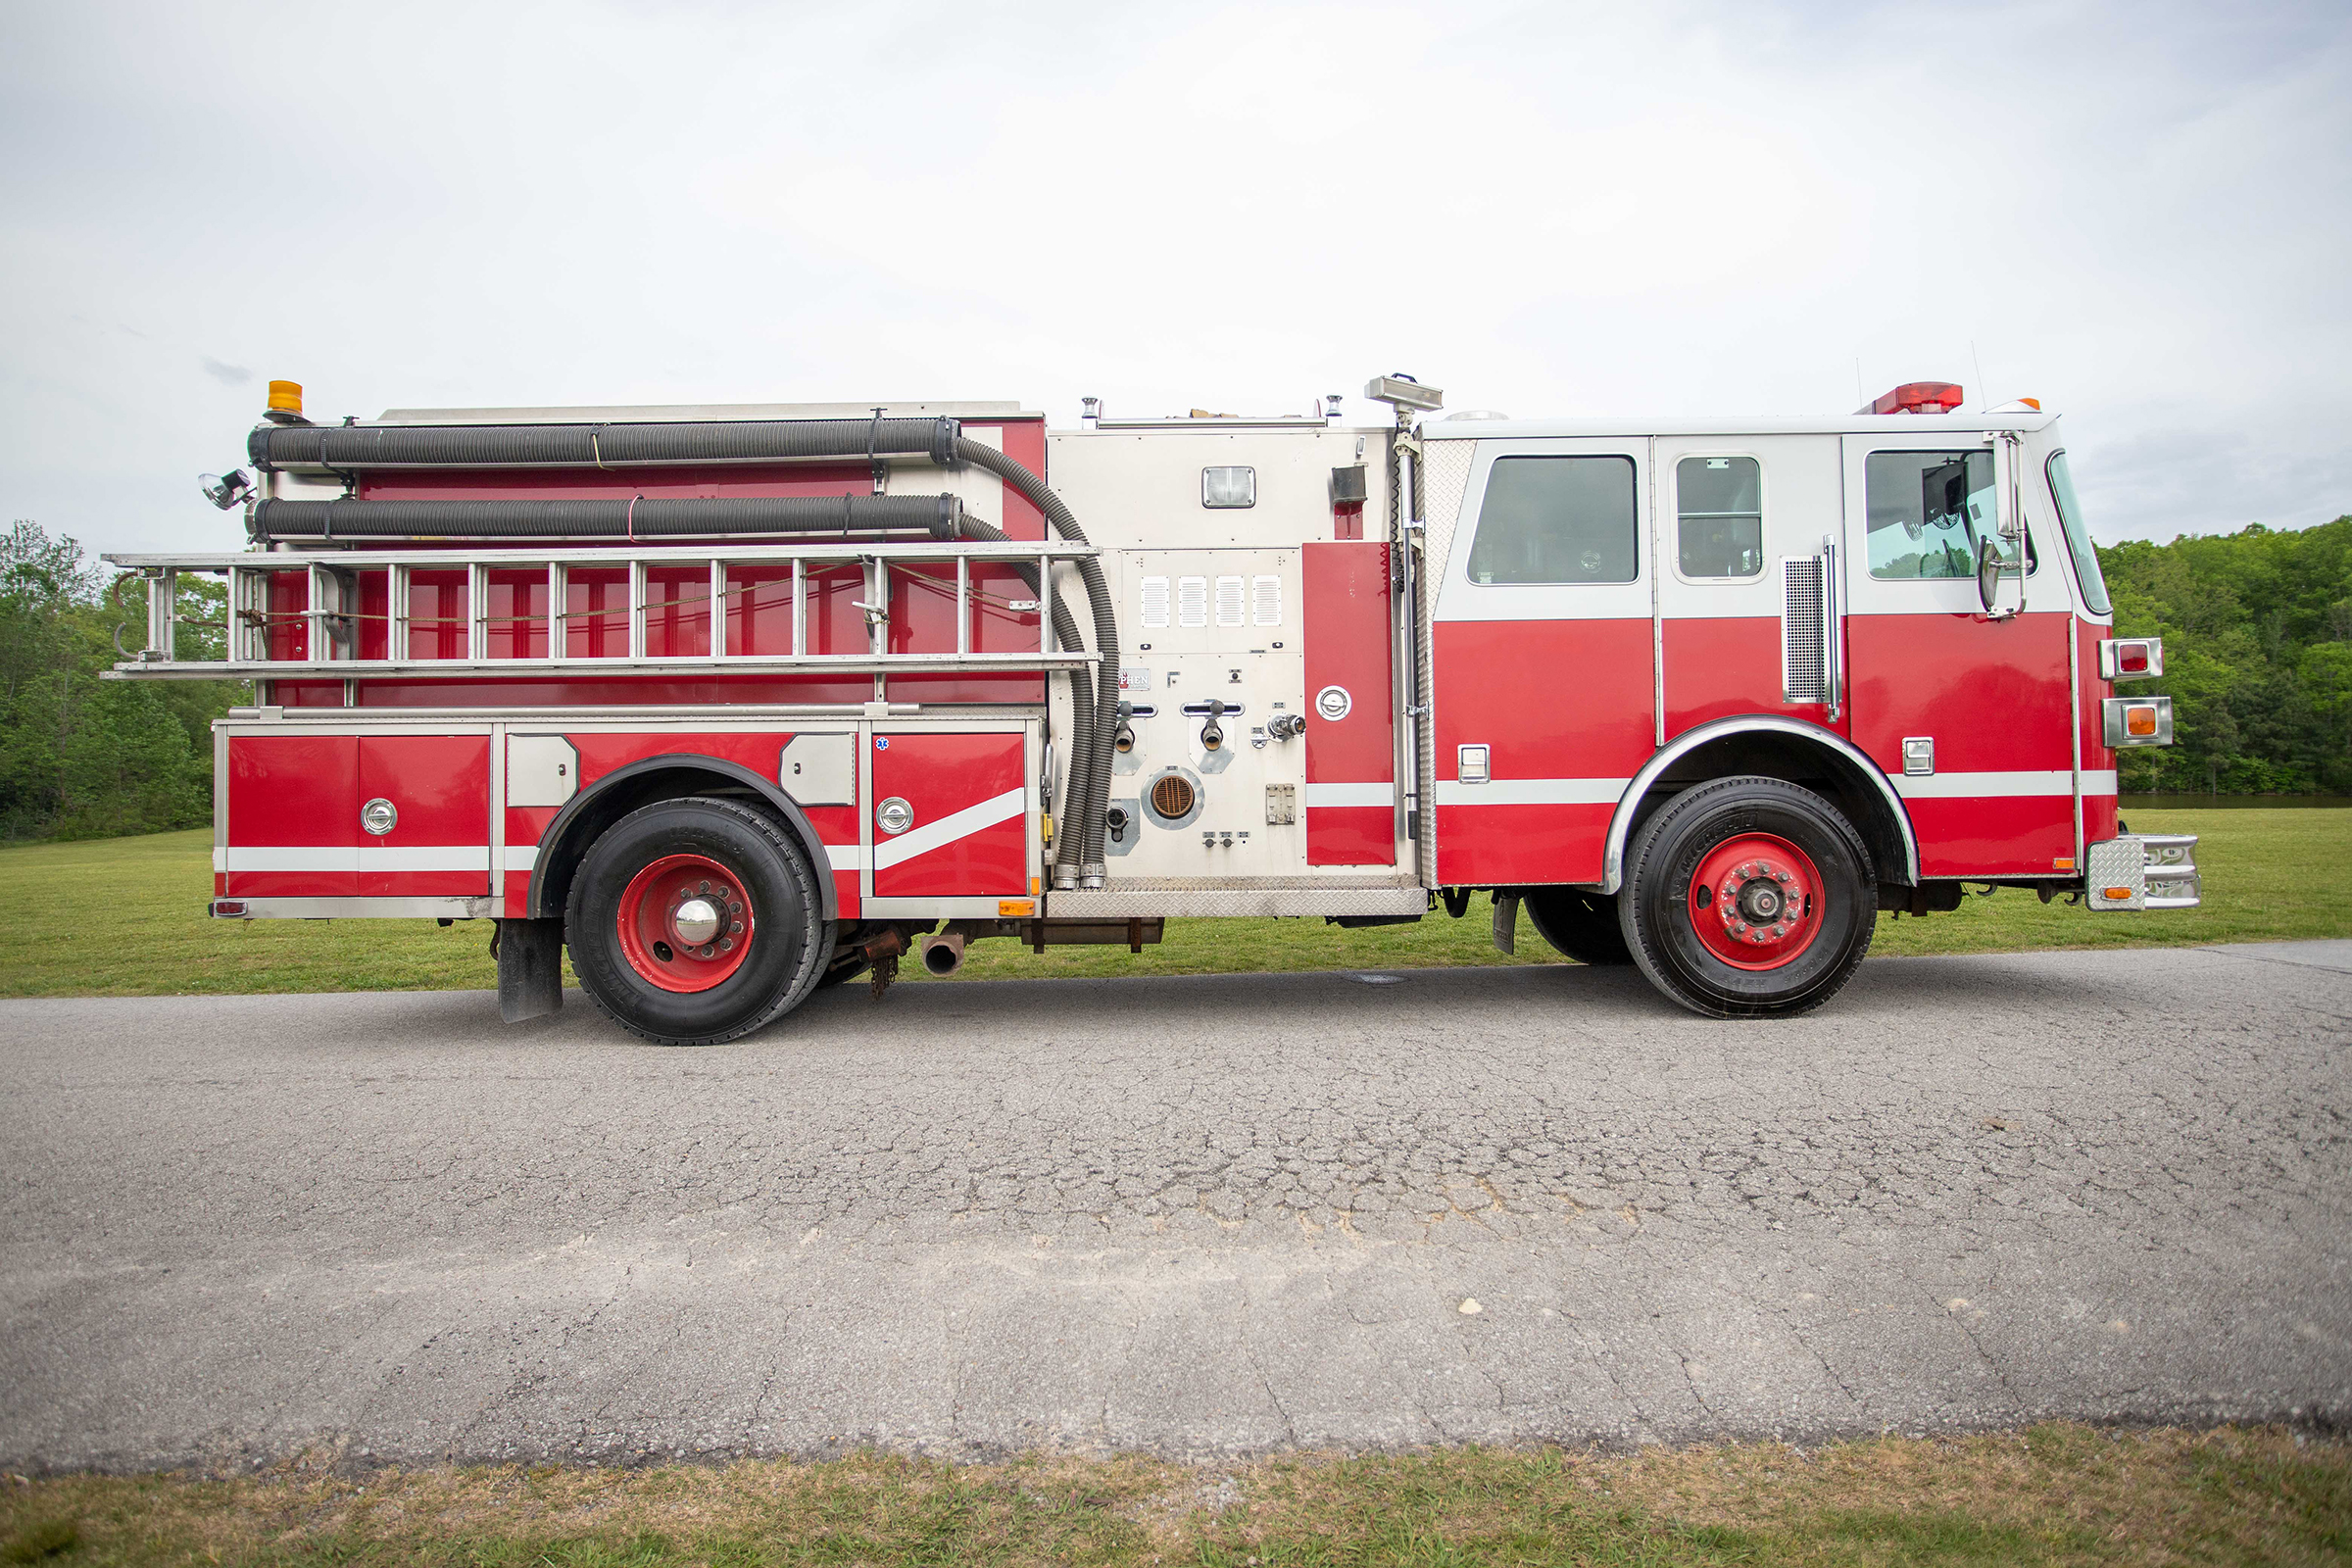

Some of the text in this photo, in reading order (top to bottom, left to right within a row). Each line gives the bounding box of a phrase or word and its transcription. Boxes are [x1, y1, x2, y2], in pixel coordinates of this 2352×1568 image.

[1118, 676, 1148, 685] PHEN
[1680, 813, 1757, 873] MICHELIN
[587, 895, 631, 1000] MICHELIN
